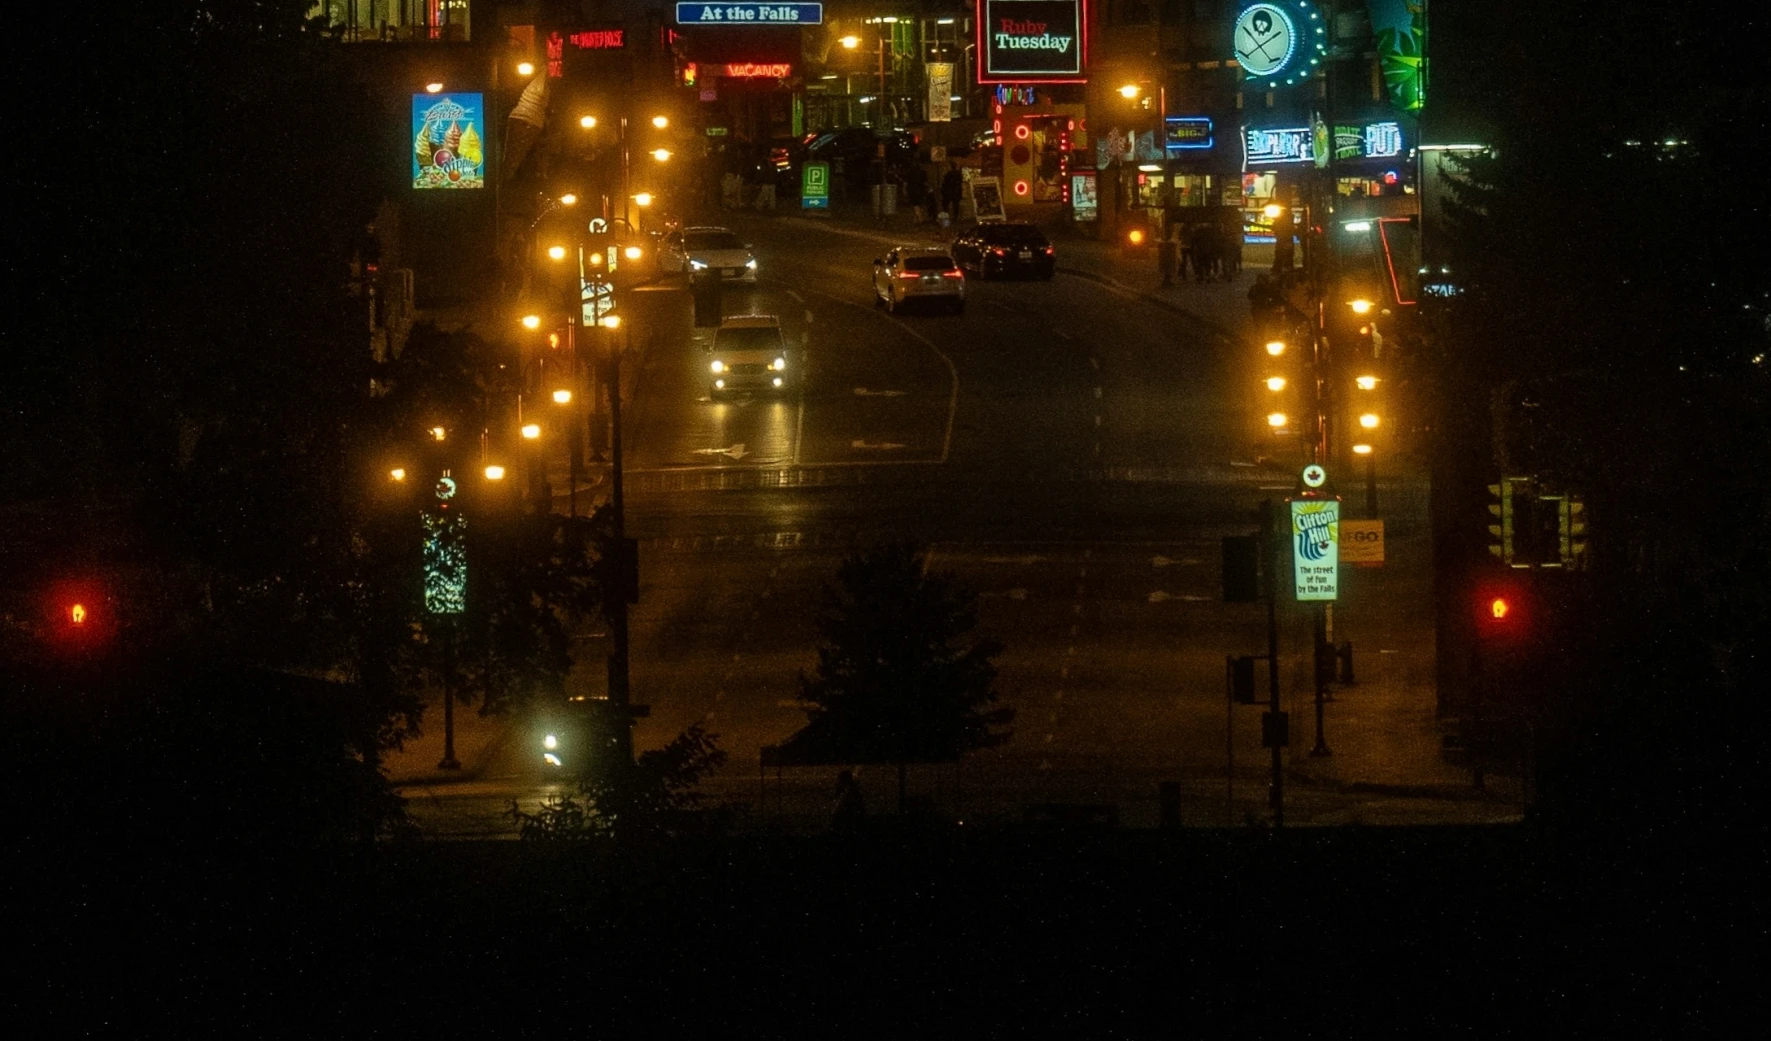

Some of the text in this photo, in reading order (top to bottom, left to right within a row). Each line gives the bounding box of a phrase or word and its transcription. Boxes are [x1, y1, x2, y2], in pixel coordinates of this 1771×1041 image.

[700, 5, 799, 21] At the Falls
[1001, 18, 1047, 35] Ruby
[995, 33, 1072, 54] Tuesday
[727, 63, 790, 77] VACANCY
[1295, 510, 1336, 532] Clifton
[1308, 525, 1332, 545] Hill
[1300, 566, 1334, 574] The street
[1298, 585, 1335, 594] by the Falls
